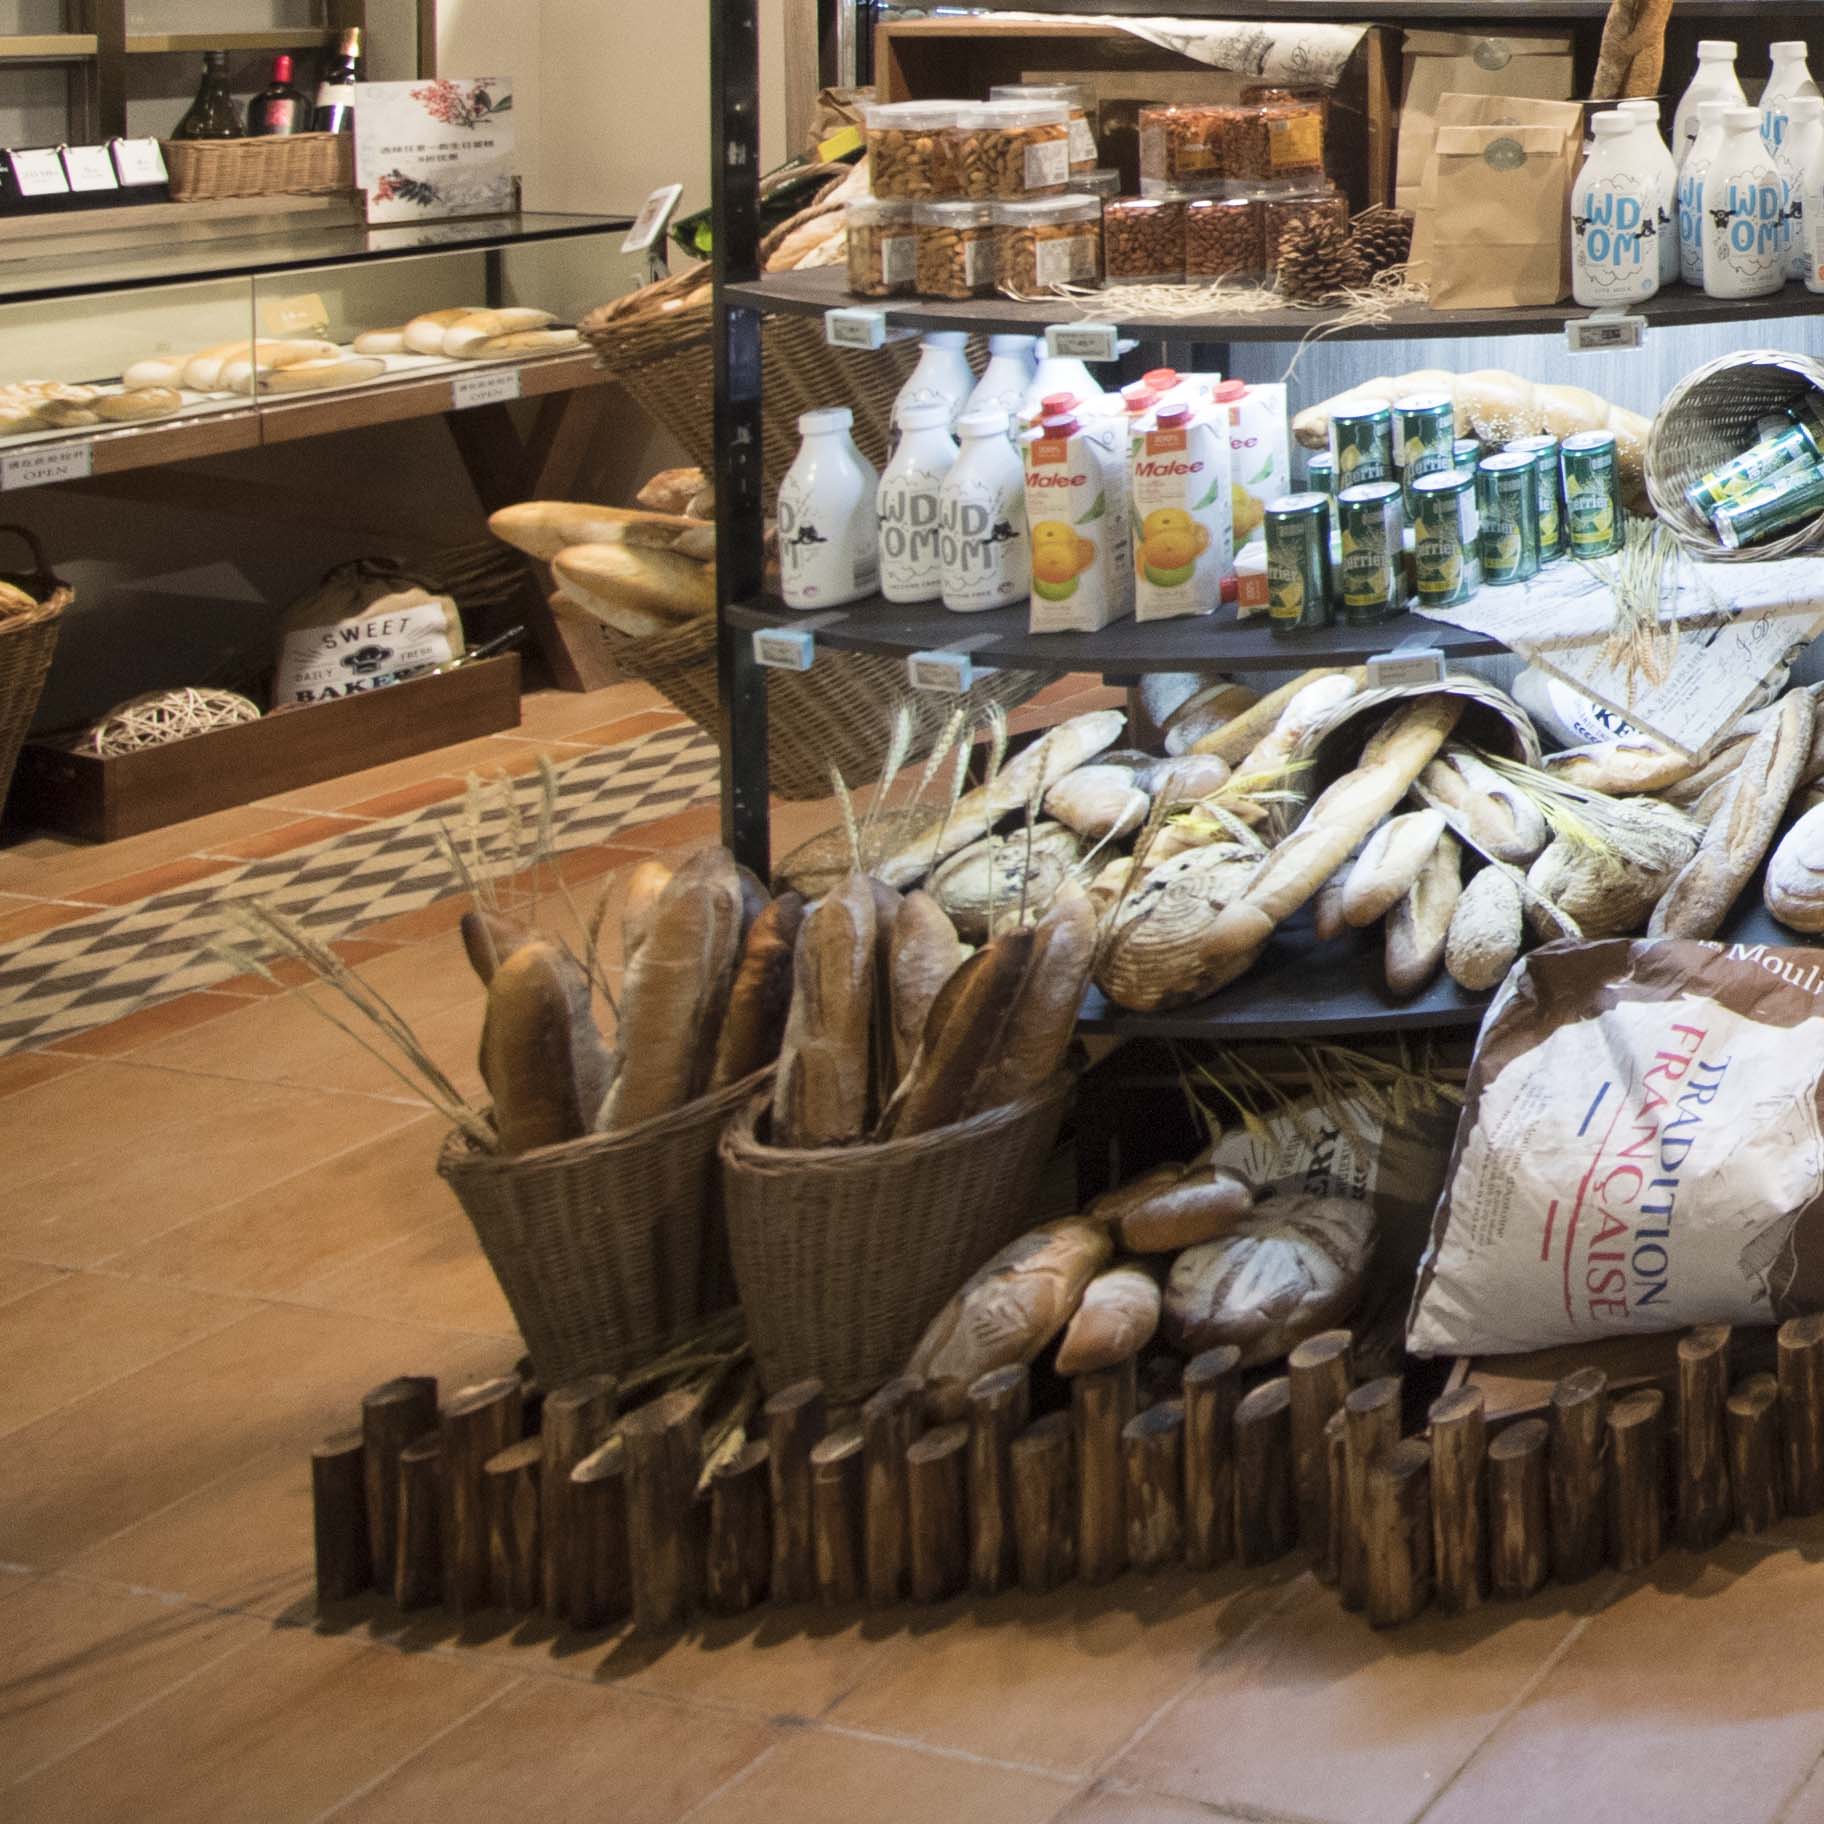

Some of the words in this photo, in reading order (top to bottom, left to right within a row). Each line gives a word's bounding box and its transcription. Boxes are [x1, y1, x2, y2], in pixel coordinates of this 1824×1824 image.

[1586, 192, 1641, 230] WD
[1729, 184, 1779, 221] WD
[1586, 228, 1641, 266] OM
[1230, 435, 1257, 451] ee
[1026, 473, 1087, 489] Malee
[1136, 460, 1205, 478] Malee
[882, 490, 938, 527] WD
[321, 617, 412, 650] SWEET
[295, 668, 335, 683] DAILY
[1585, 1023, 1709, 1322] FRANÇAISE
[1630, 1055, 1732, 1308] TRADITION
